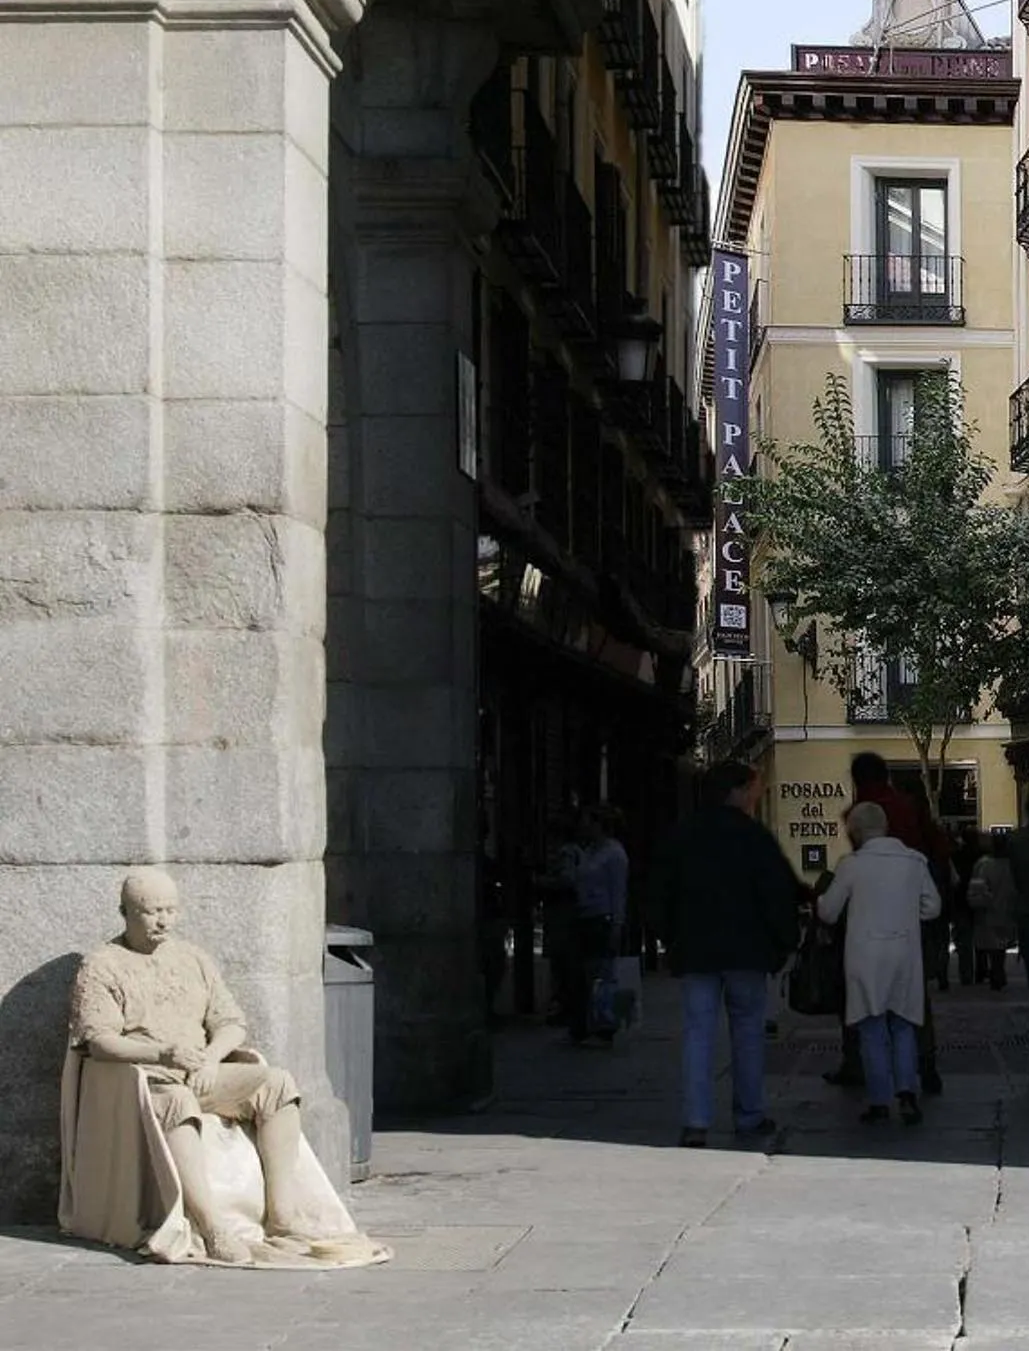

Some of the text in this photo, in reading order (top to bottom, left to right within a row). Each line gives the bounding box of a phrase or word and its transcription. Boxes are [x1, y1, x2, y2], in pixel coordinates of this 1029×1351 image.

[720, 259, 745, 593] PETIT PALACE
[780, 782, 845, 799] POSADA
[801, 802, 824, 817] del
[789, 821, 839, 838] PEINE
